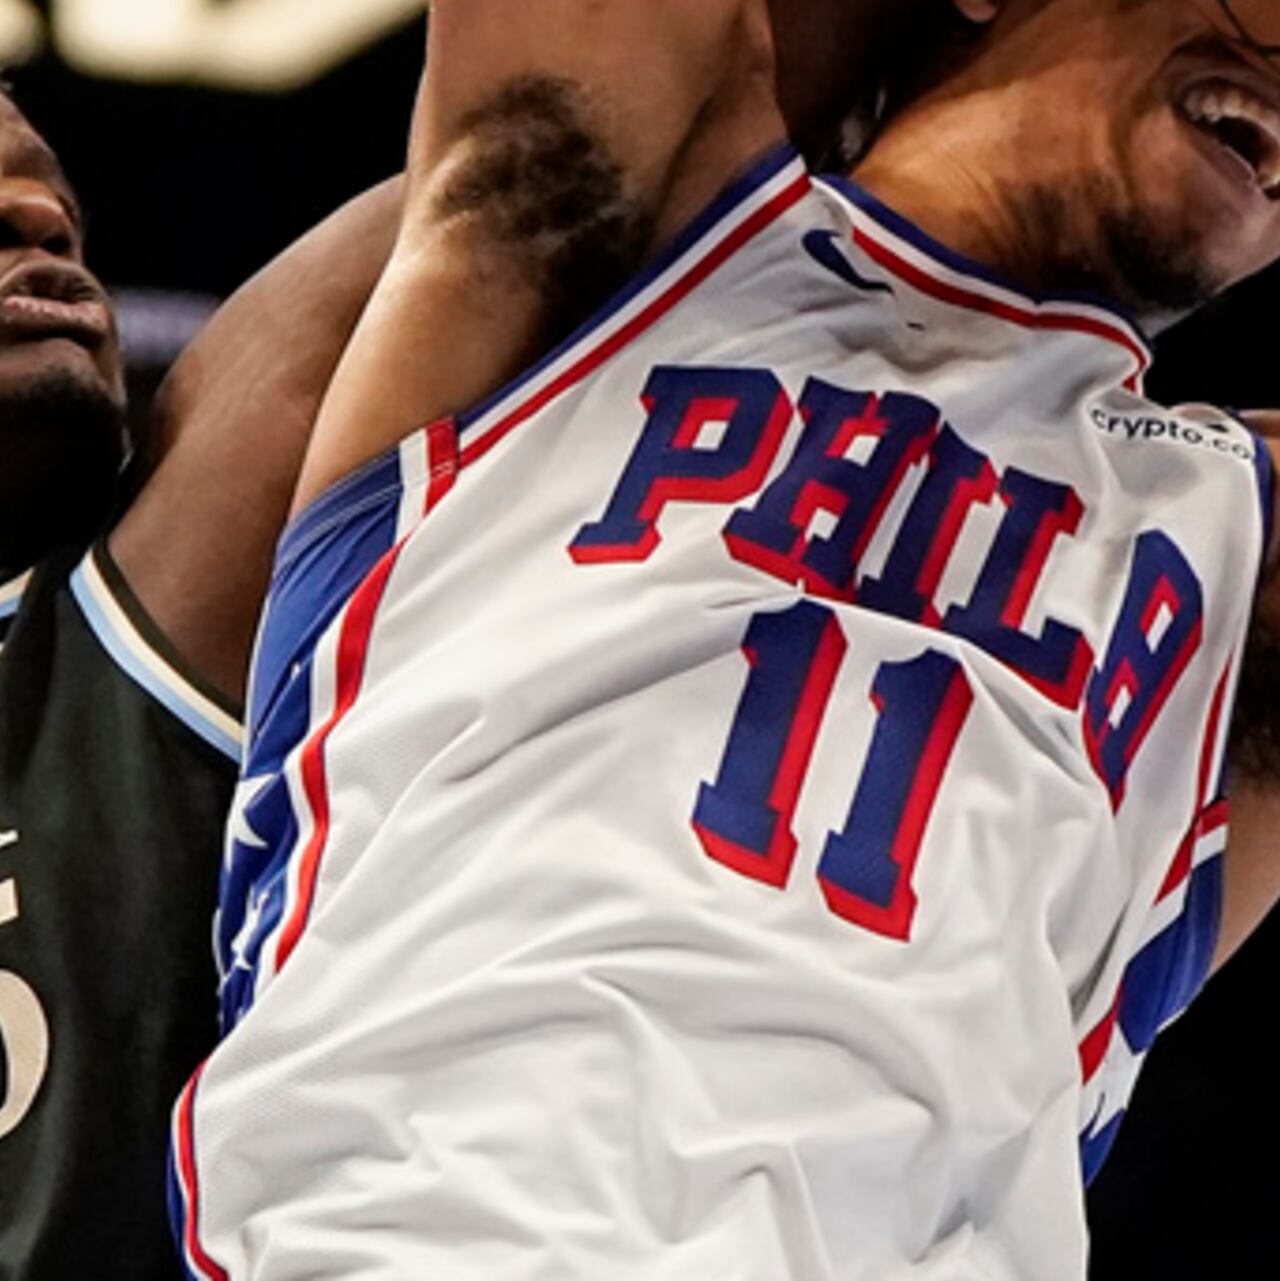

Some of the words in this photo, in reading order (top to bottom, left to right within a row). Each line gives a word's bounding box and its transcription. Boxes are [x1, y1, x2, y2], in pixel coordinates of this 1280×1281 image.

[568, 365, 1204, 815] PHILA
[1091, 409, 1252, 460] crypto.co
[690, 598, 975, 943] 11
